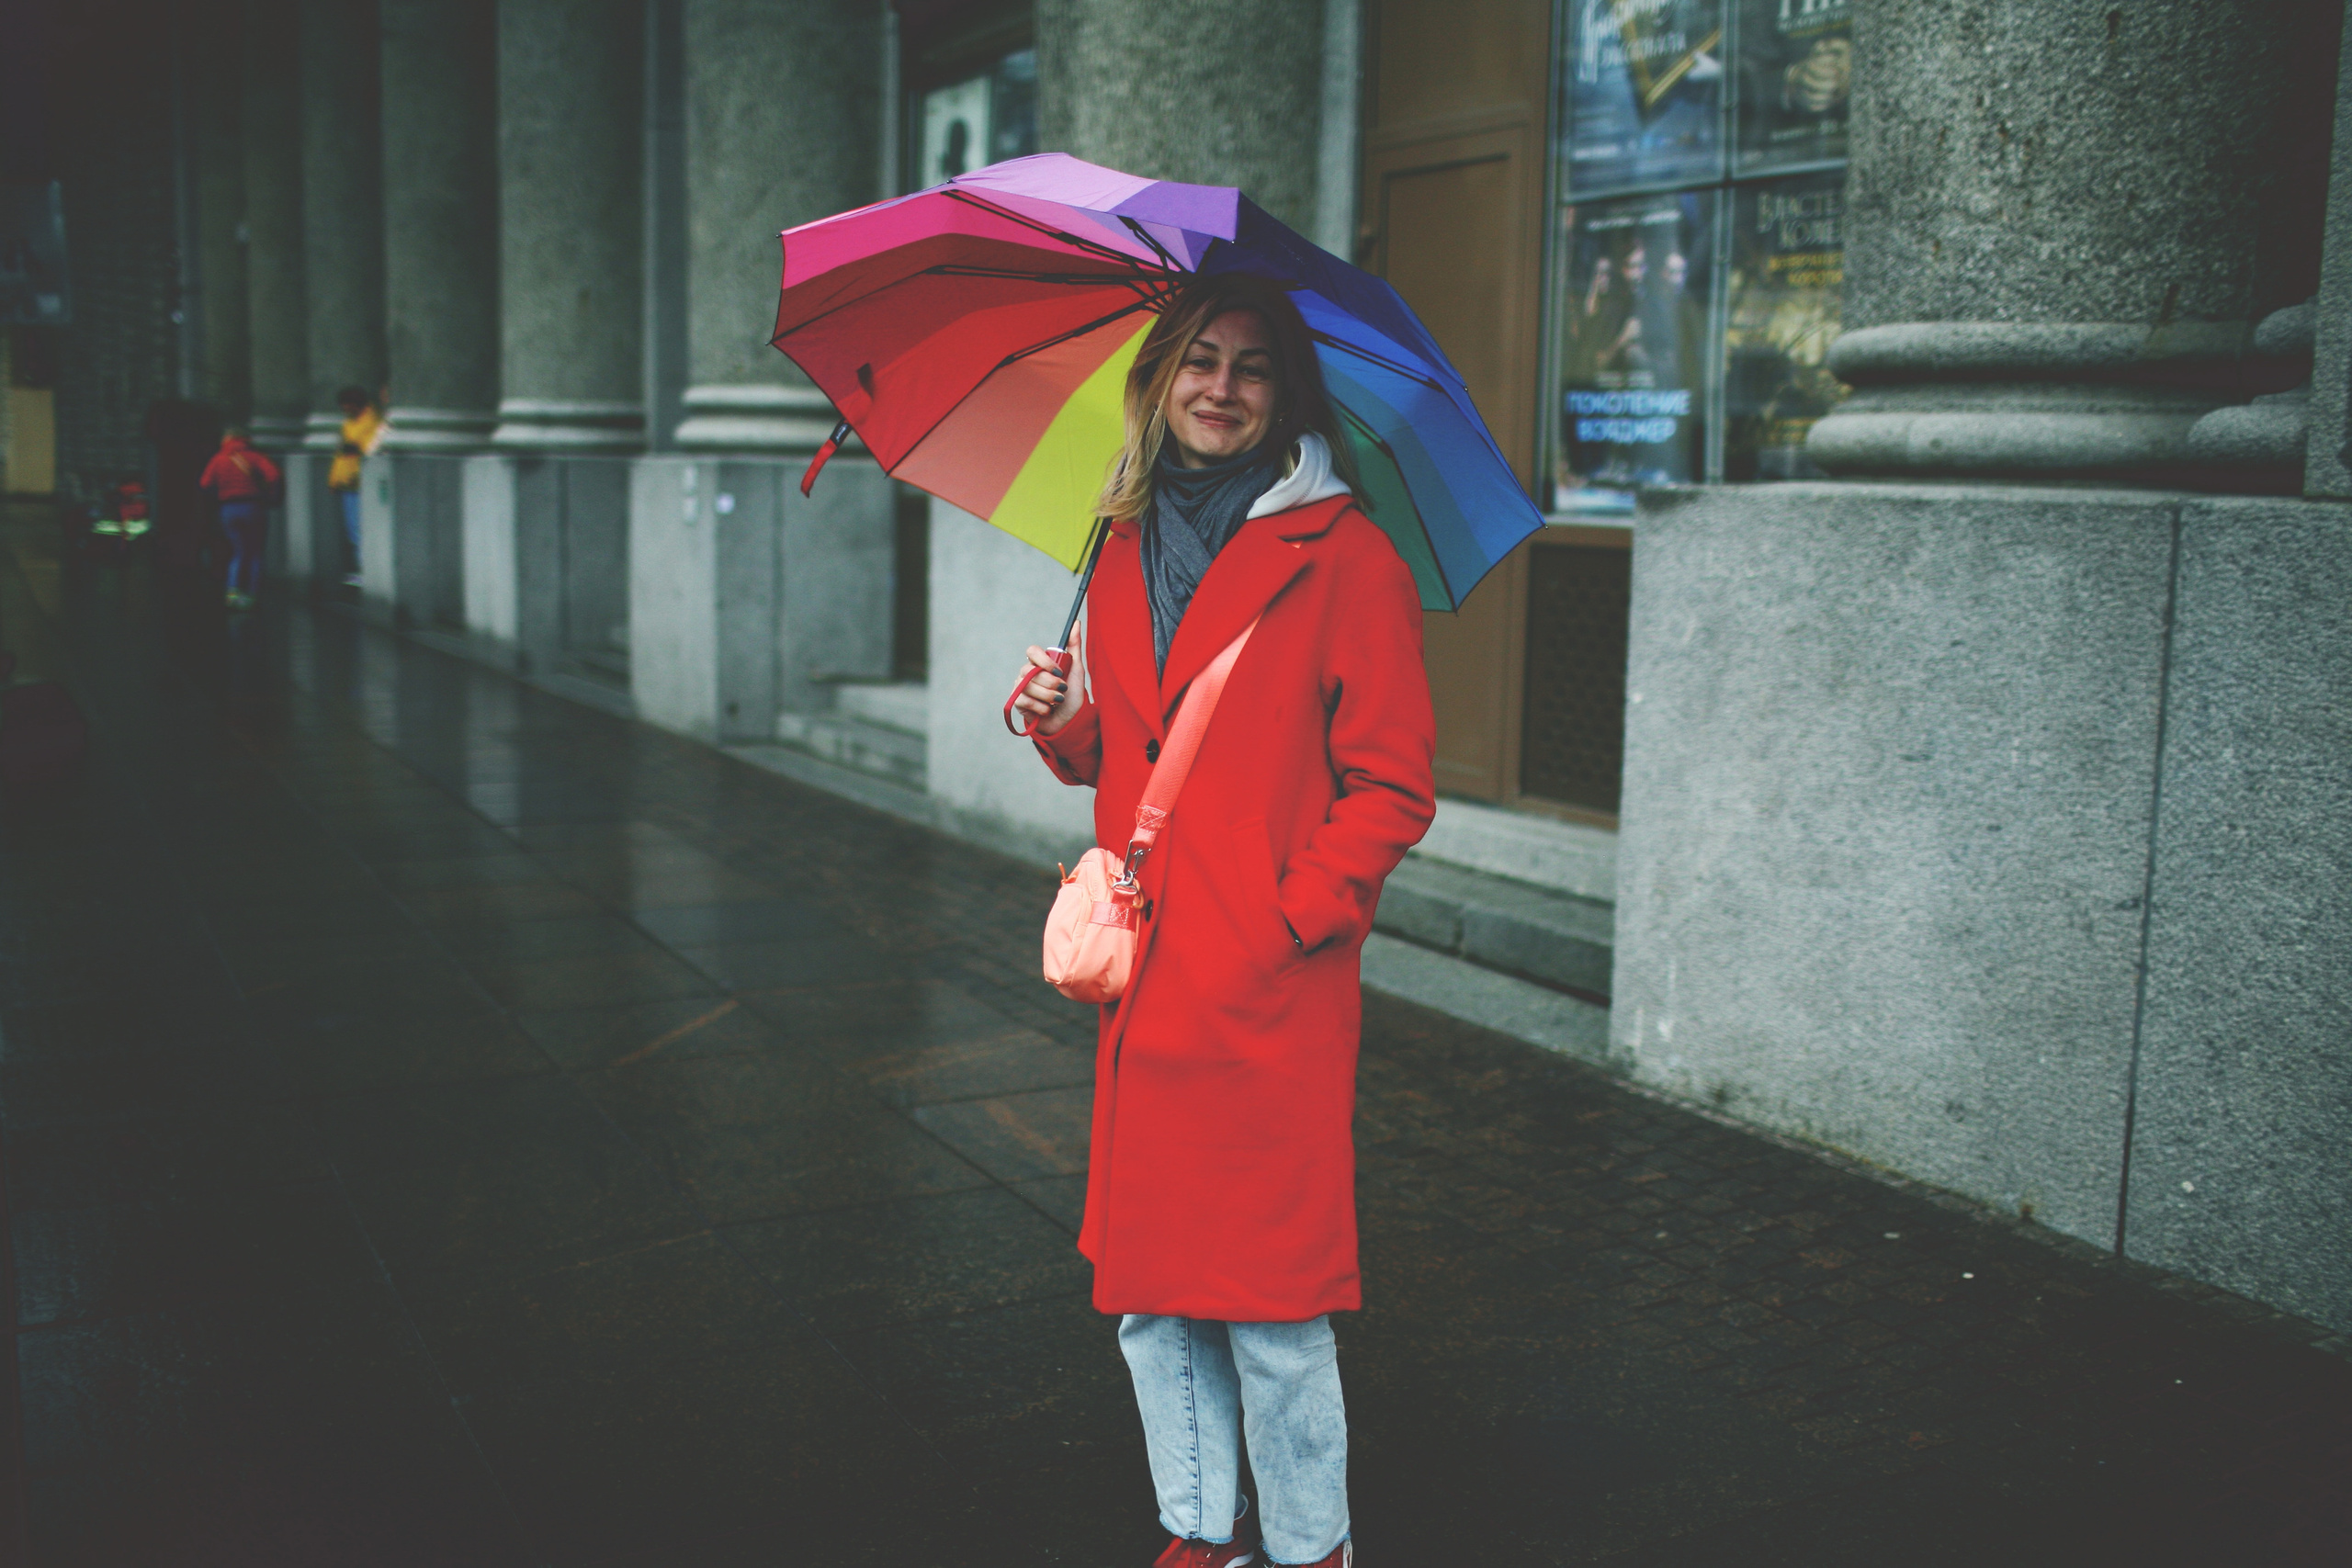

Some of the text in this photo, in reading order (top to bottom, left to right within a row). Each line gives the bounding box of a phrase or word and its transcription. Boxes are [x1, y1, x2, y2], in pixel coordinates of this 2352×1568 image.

[1758, 191, 1842, 233] ВЛАСТЕ
[1780, 219, 1842, 248] КОЛЕ
[1566, 389, 1690, 415] ПОКОЛЕНИЕ
[1576, 417, 1677, 445] ВОЯДЖЕР
